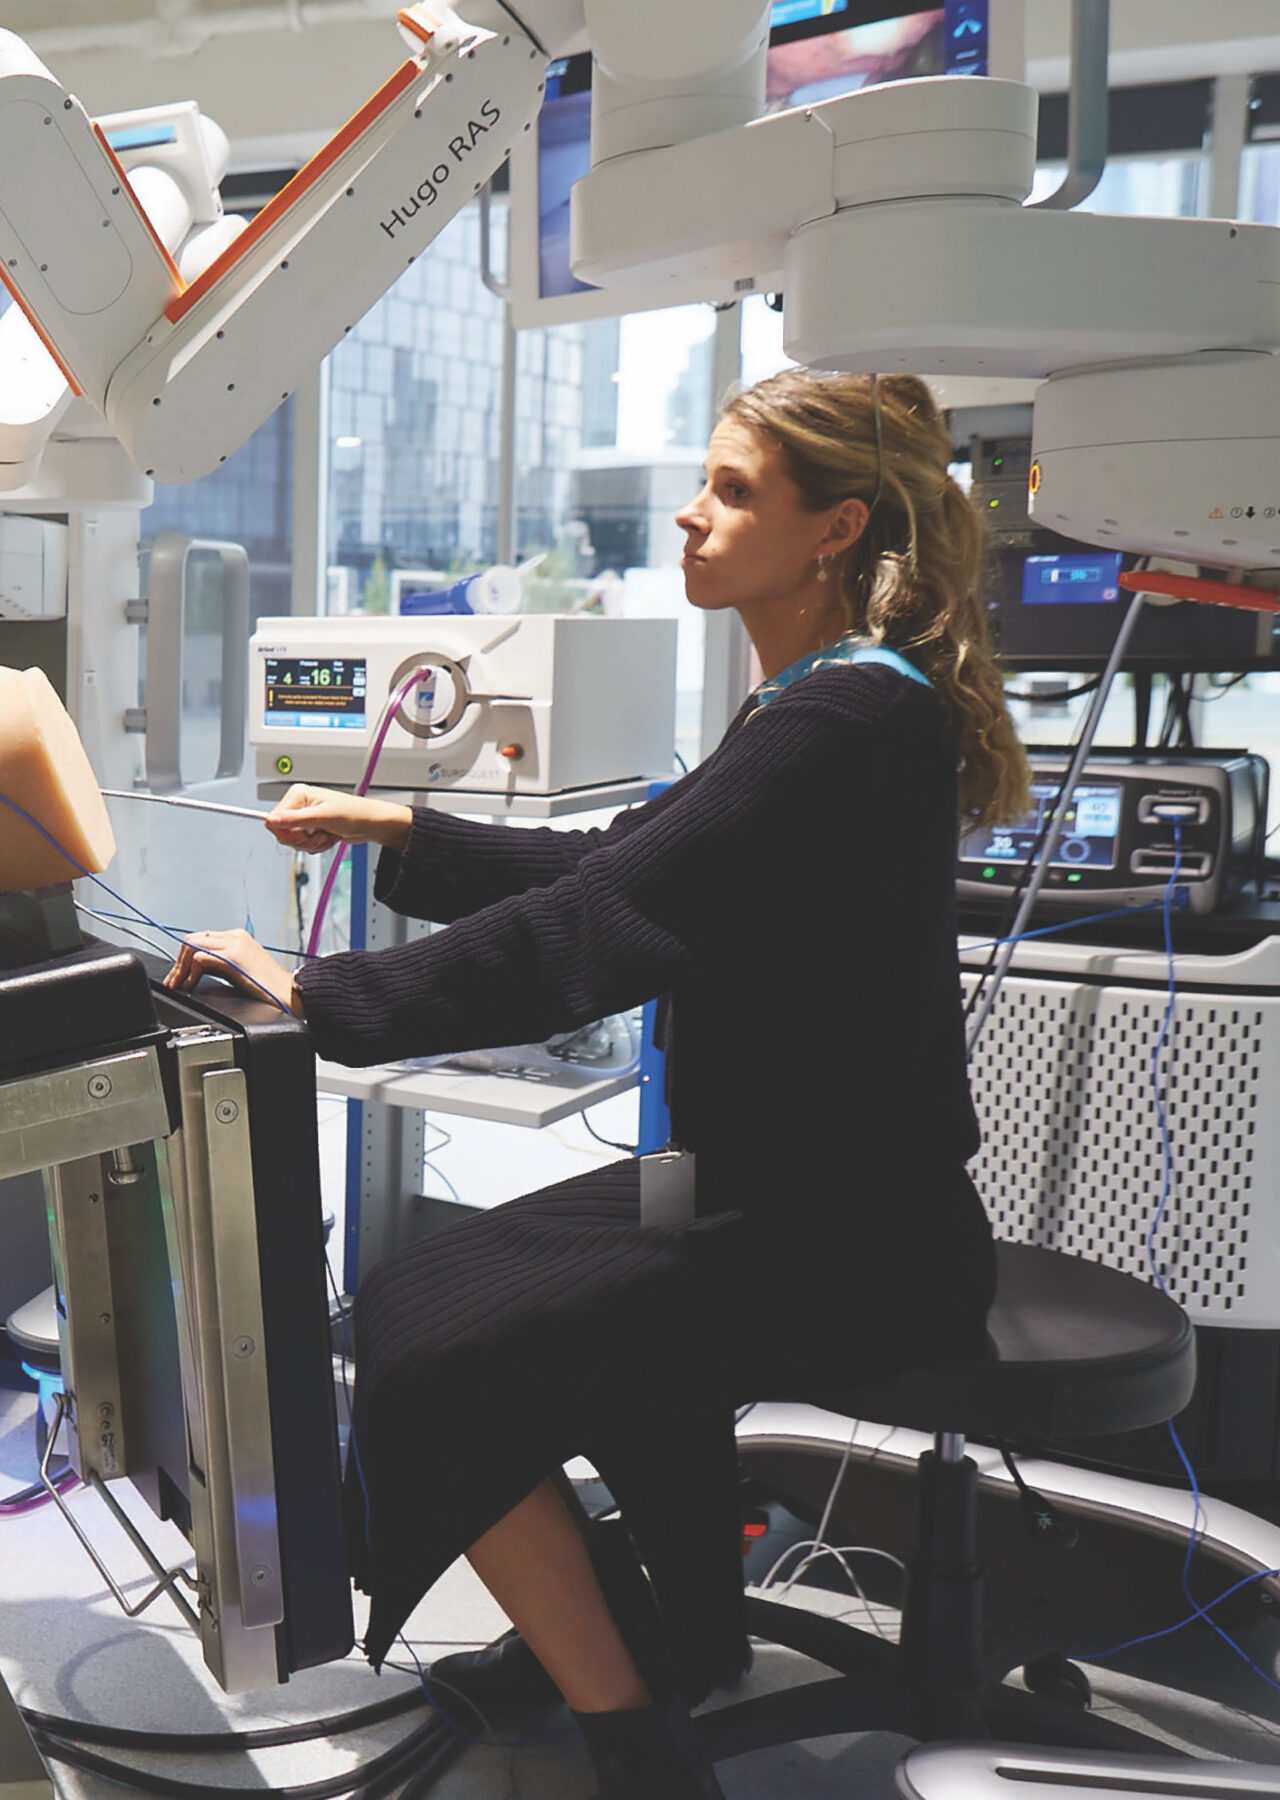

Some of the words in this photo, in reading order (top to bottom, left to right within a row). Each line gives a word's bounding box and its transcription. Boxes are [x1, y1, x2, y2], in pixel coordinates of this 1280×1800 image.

[380, 164, 449, 239] Hugo
[448, 99, 501, 162] RAS
[283, 671, 293, 686] 4
[311, 668, 331, 686] 16
